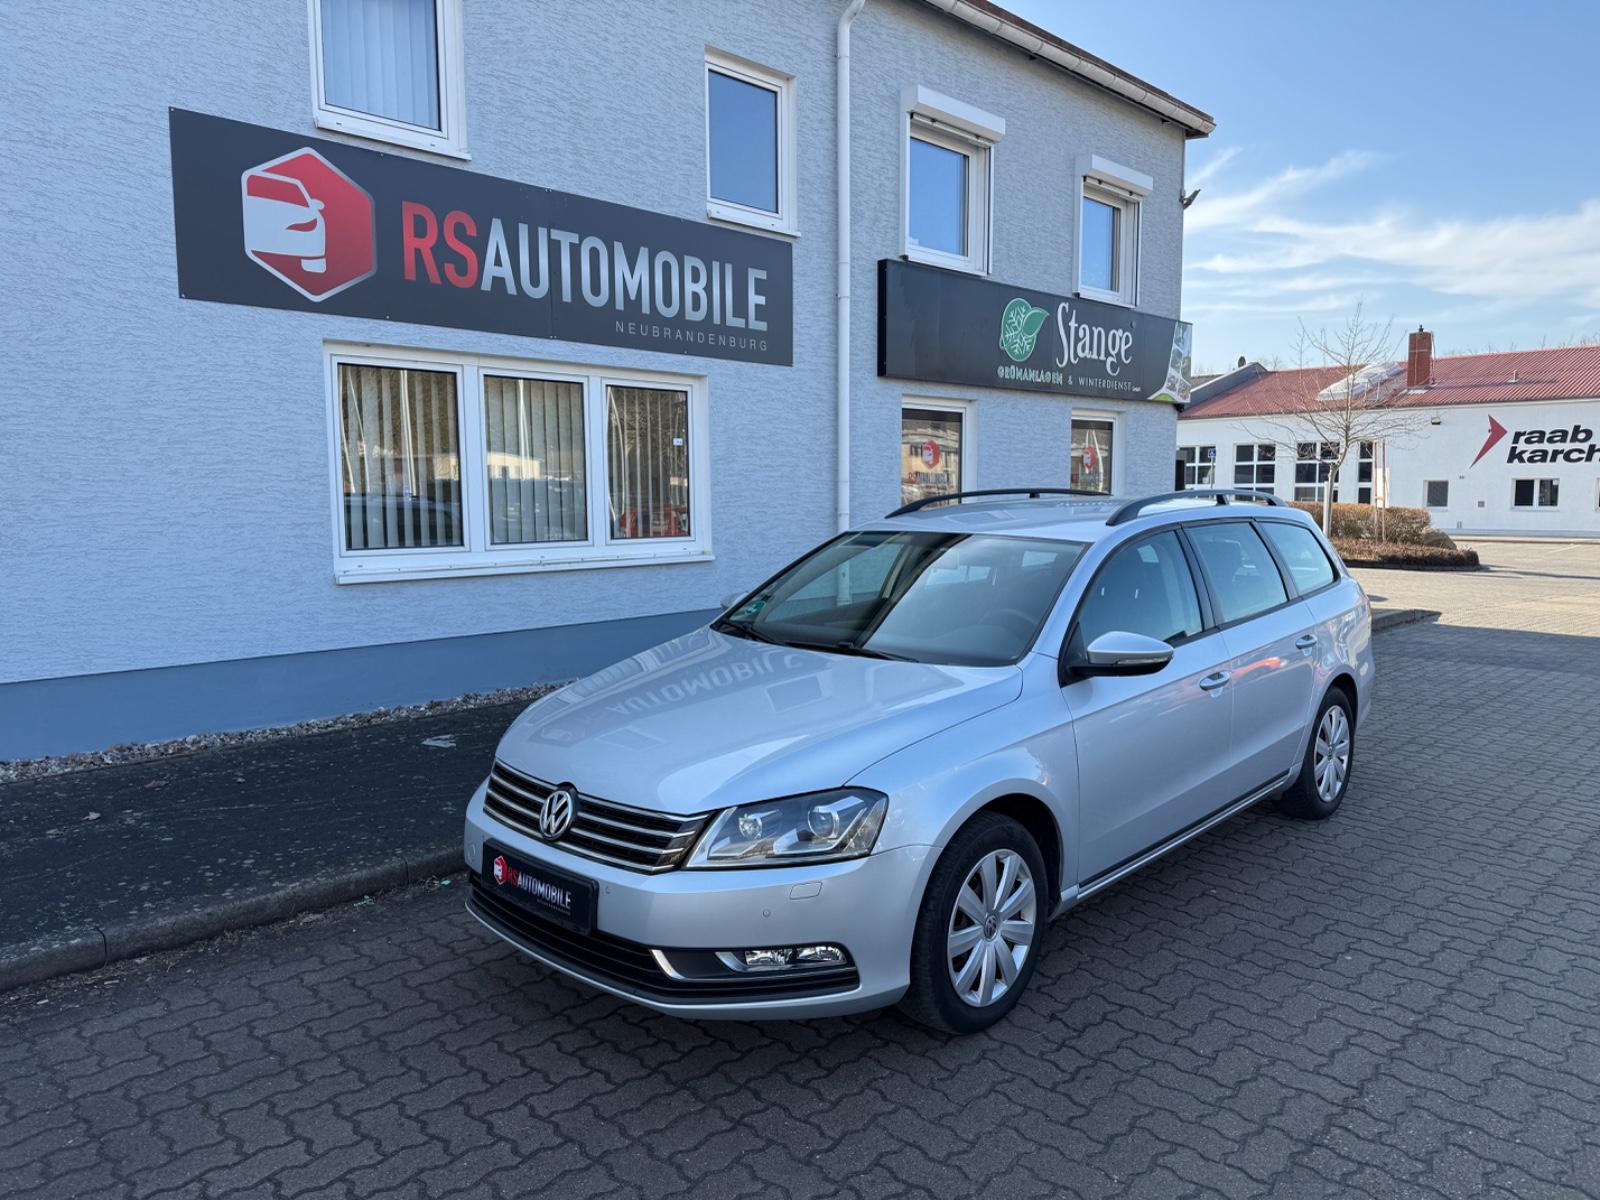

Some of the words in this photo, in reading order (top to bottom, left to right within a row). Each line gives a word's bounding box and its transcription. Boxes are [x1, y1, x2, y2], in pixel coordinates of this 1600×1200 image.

[402, 200, 768, 331] RSAUTOMOBILE
[615, 320, 768, 352] NEUBRANDENBURG
[1056, 302, 1133, 376] Stange
[1078, 376, 1132, 391] WINTERDIENST
[1512, 425, 1593, 445] raab
